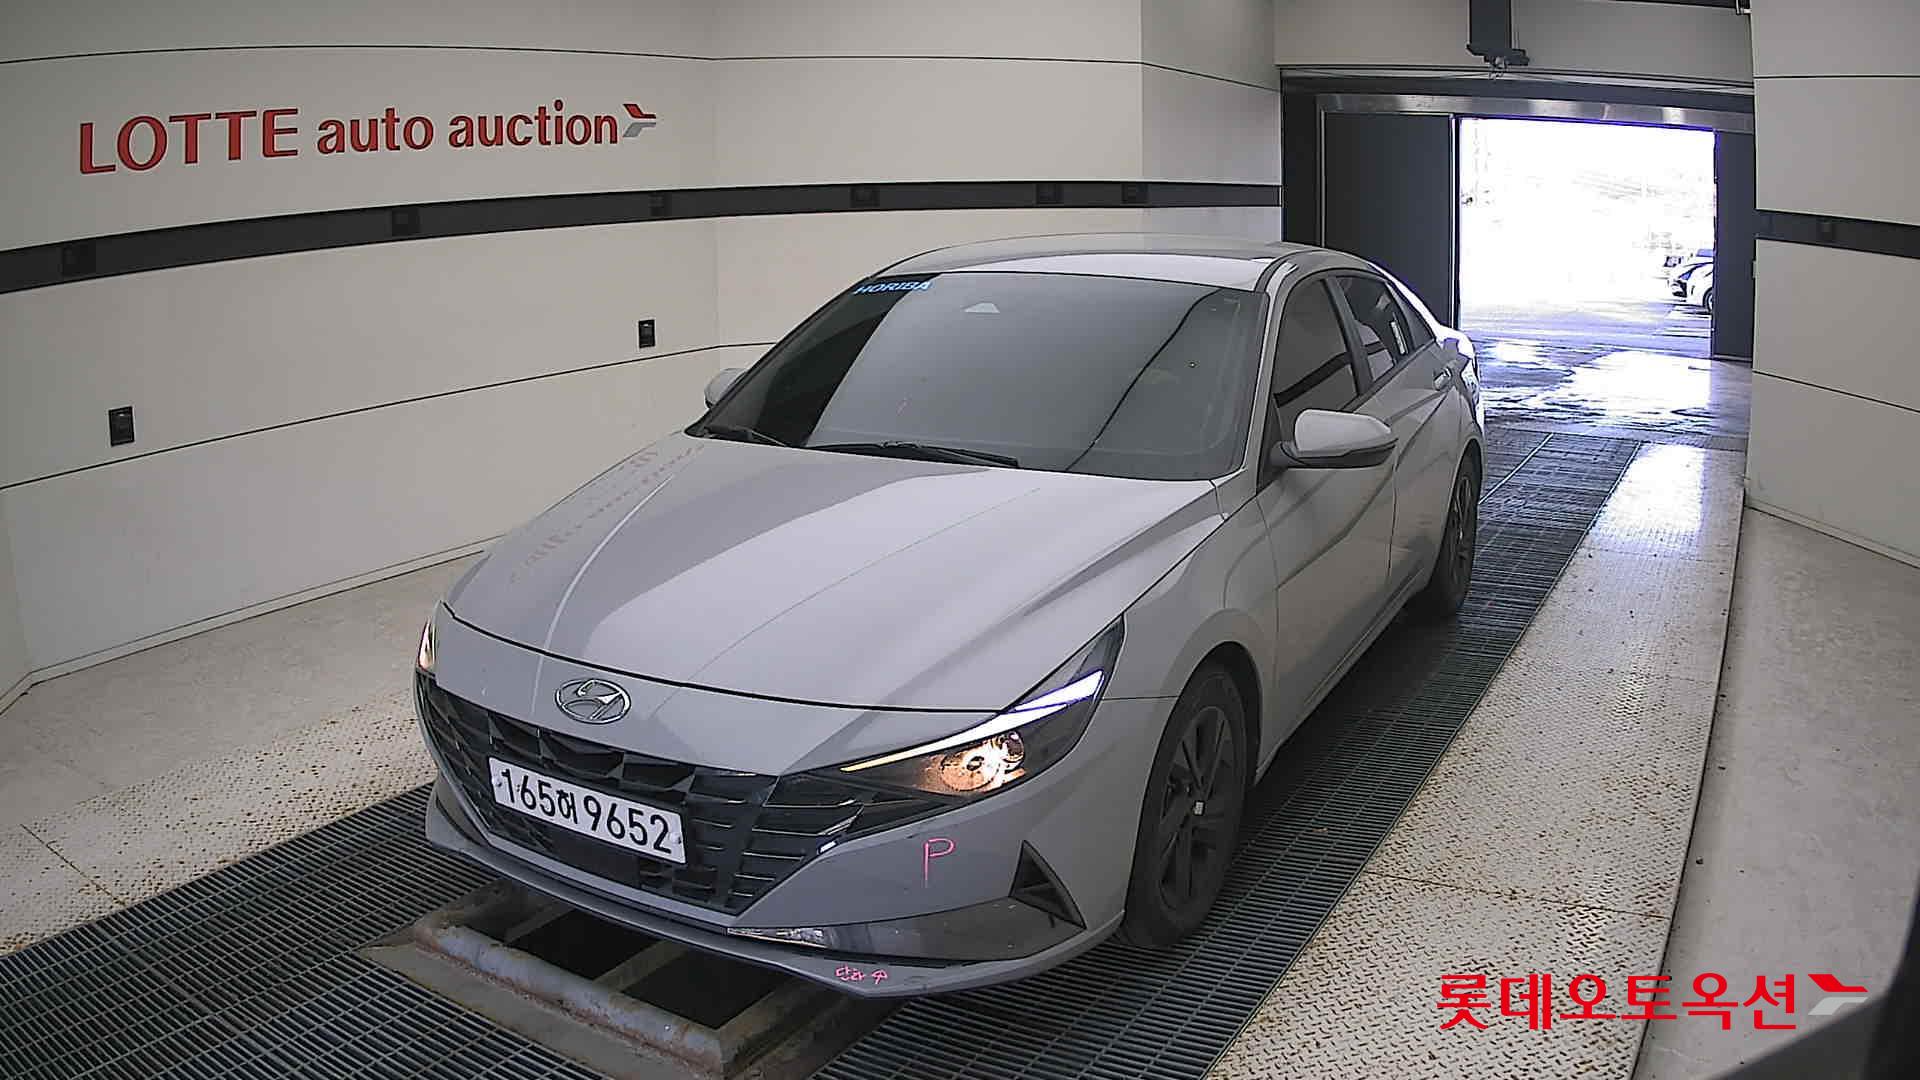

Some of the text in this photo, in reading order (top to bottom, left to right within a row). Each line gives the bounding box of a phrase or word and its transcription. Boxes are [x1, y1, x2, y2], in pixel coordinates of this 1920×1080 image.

[80, 100, 619, 174] LOTTE auto auction
[853, 281, 934, 295] HORIBA
[924, 837, 955, 884] P
